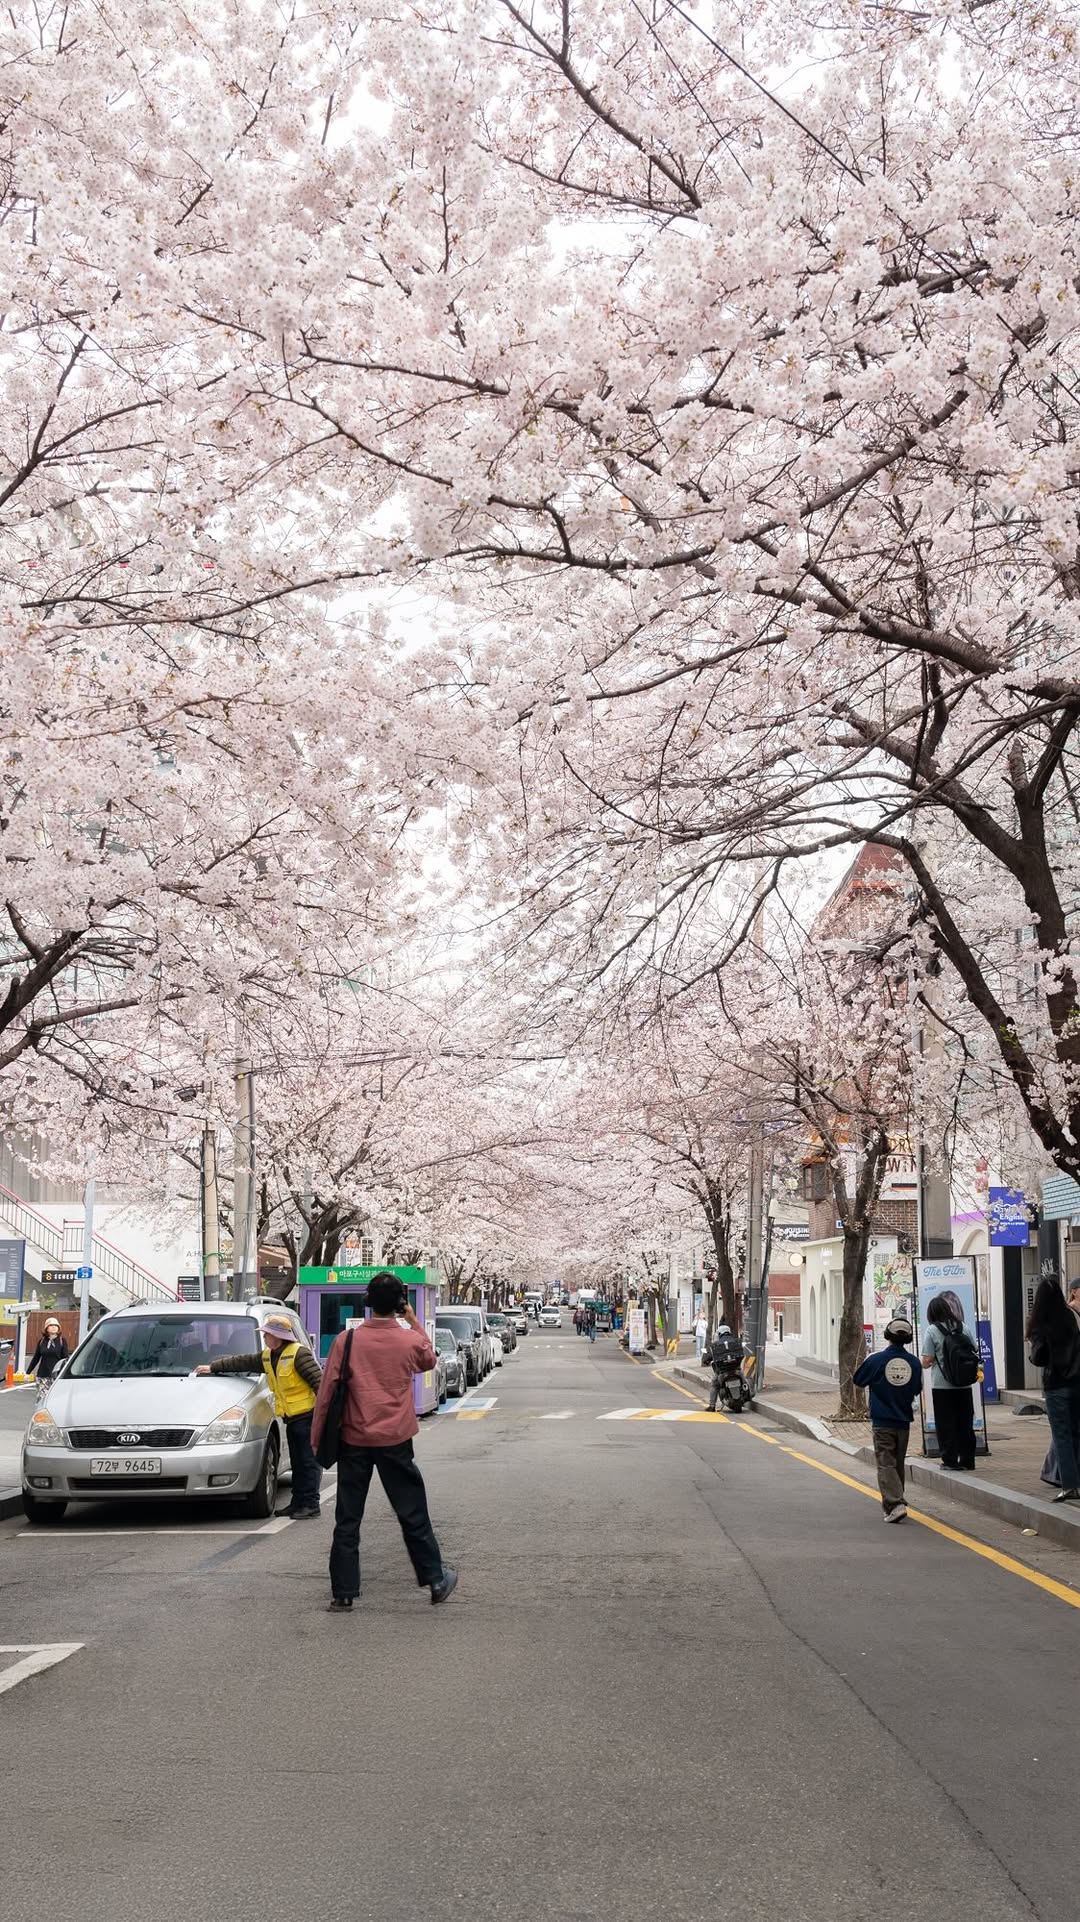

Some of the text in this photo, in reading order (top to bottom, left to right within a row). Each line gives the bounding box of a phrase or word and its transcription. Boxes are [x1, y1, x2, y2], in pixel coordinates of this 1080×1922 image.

[923, 1264, 967, 1278] The Film
[124, 1460, 155, 1472] 9645
